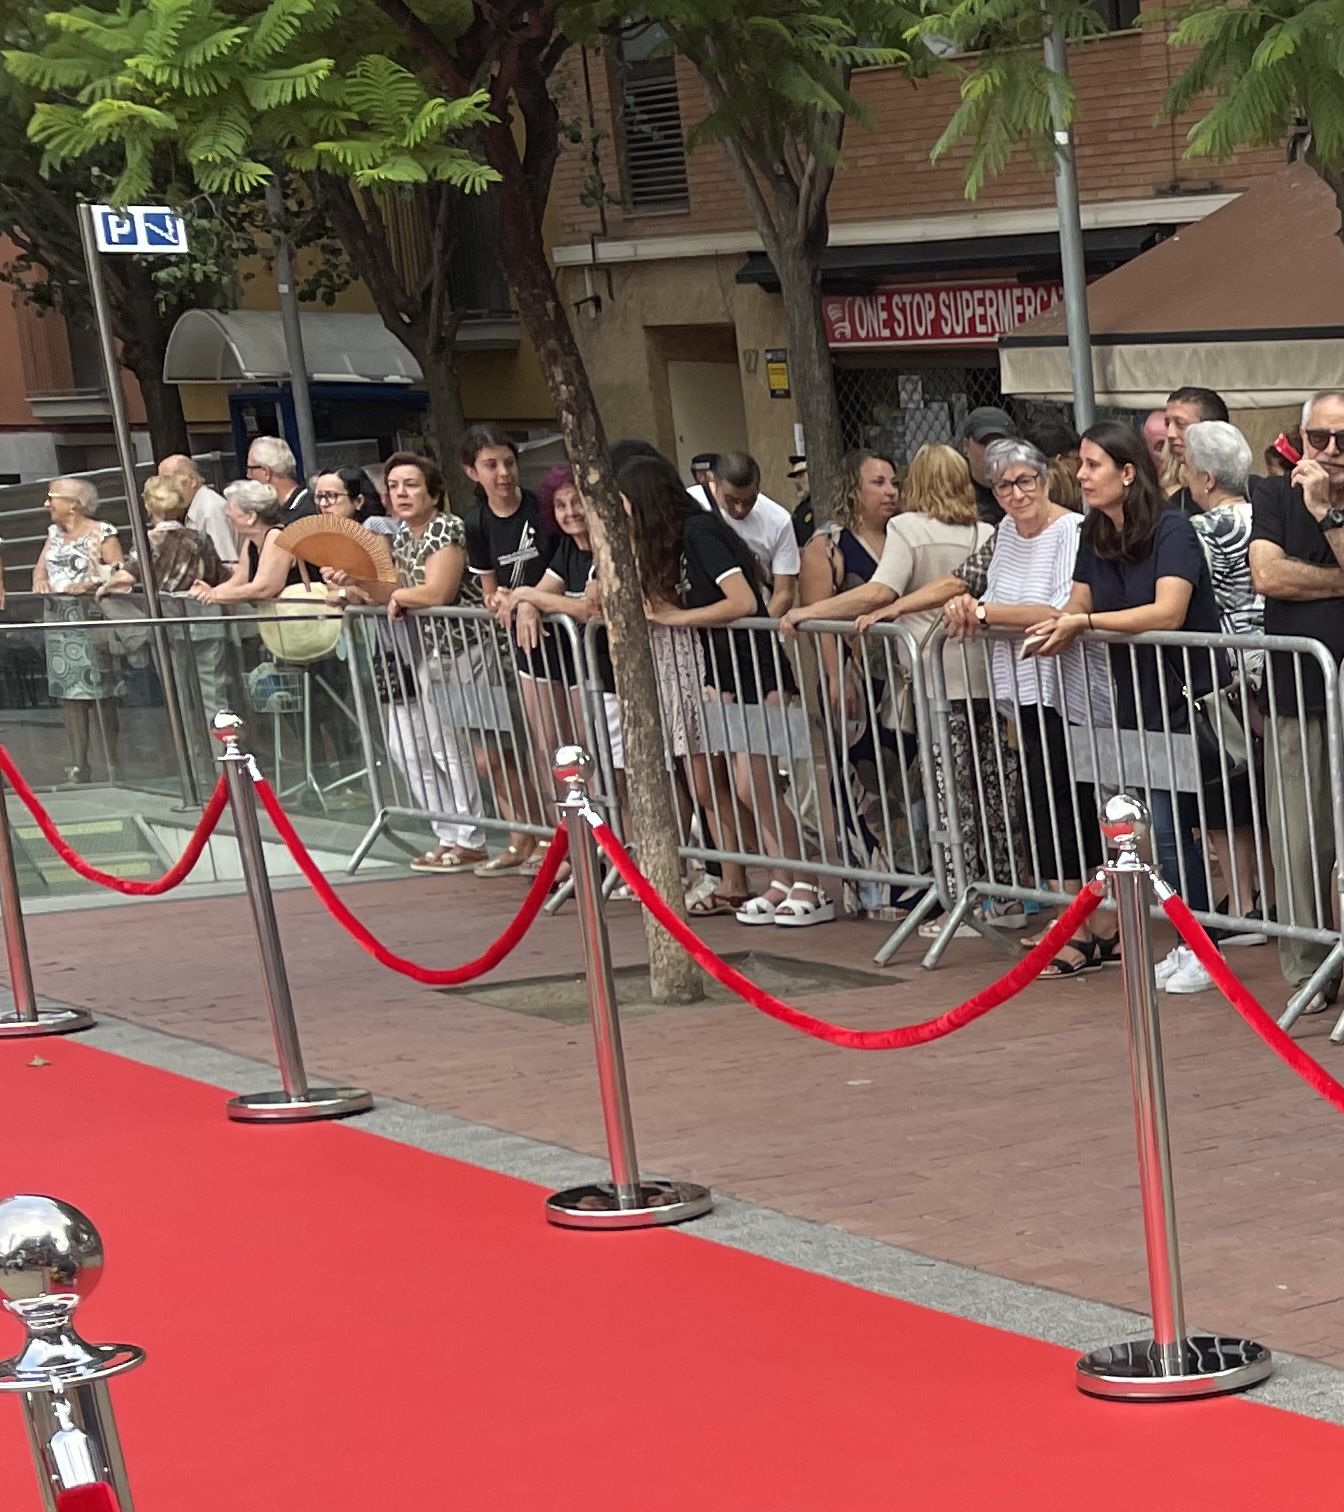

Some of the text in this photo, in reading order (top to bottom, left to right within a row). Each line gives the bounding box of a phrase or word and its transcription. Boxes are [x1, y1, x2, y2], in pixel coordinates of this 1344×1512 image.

[107, 214, 131, 243] P
[854, 295, 890, 338] ONE
[892, 290, 936, 338] STOP
